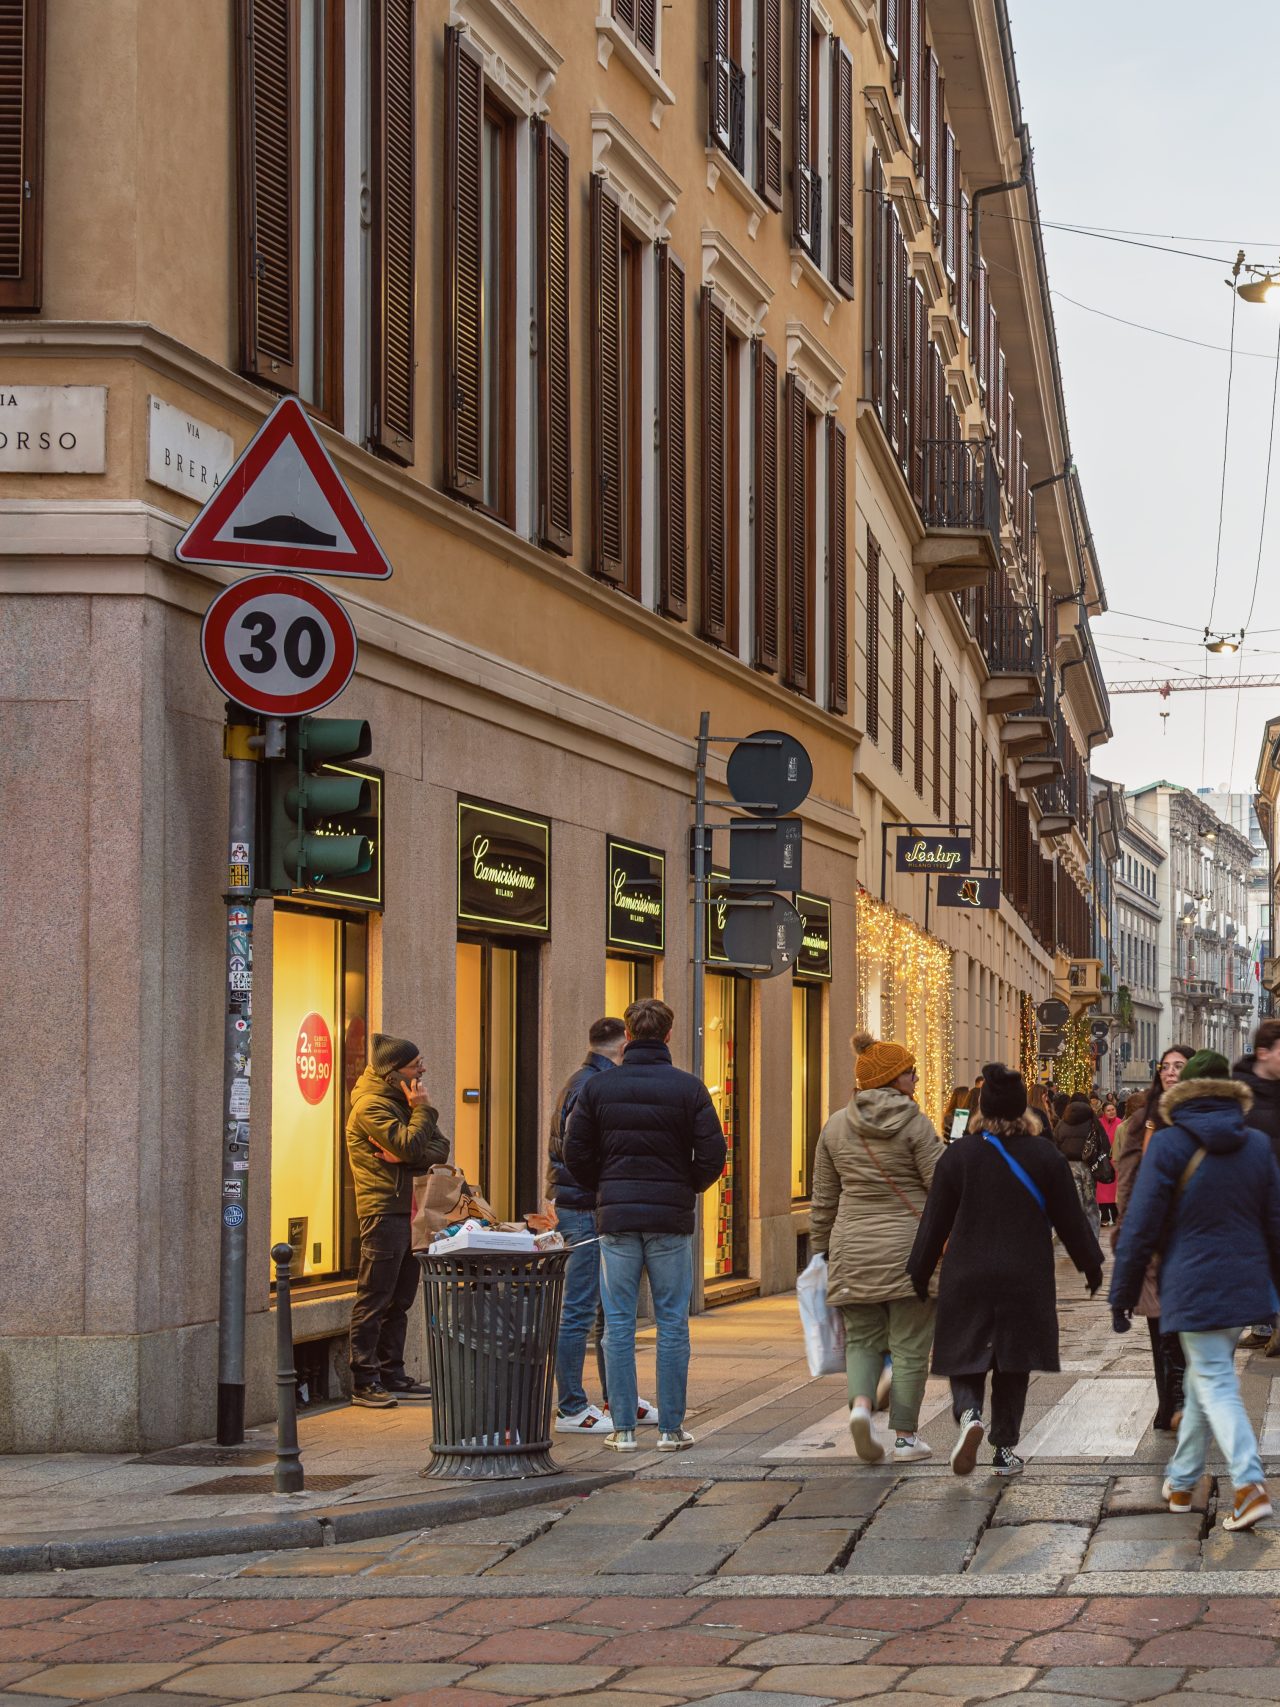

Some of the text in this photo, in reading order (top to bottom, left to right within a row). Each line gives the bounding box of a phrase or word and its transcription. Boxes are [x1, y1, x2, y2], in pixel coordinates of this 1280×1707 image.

[186, 422, 200, 439] VIA
[165, 448, 220, 488] BRERA
[239, 611, 326, 679] 30
[473, 835, 535, 890] Camicissima
[905, 841, 961, 869] Sealup
[495, 888, 513, 898] MILANO
[613, 868, 660, 916] Camicissima
